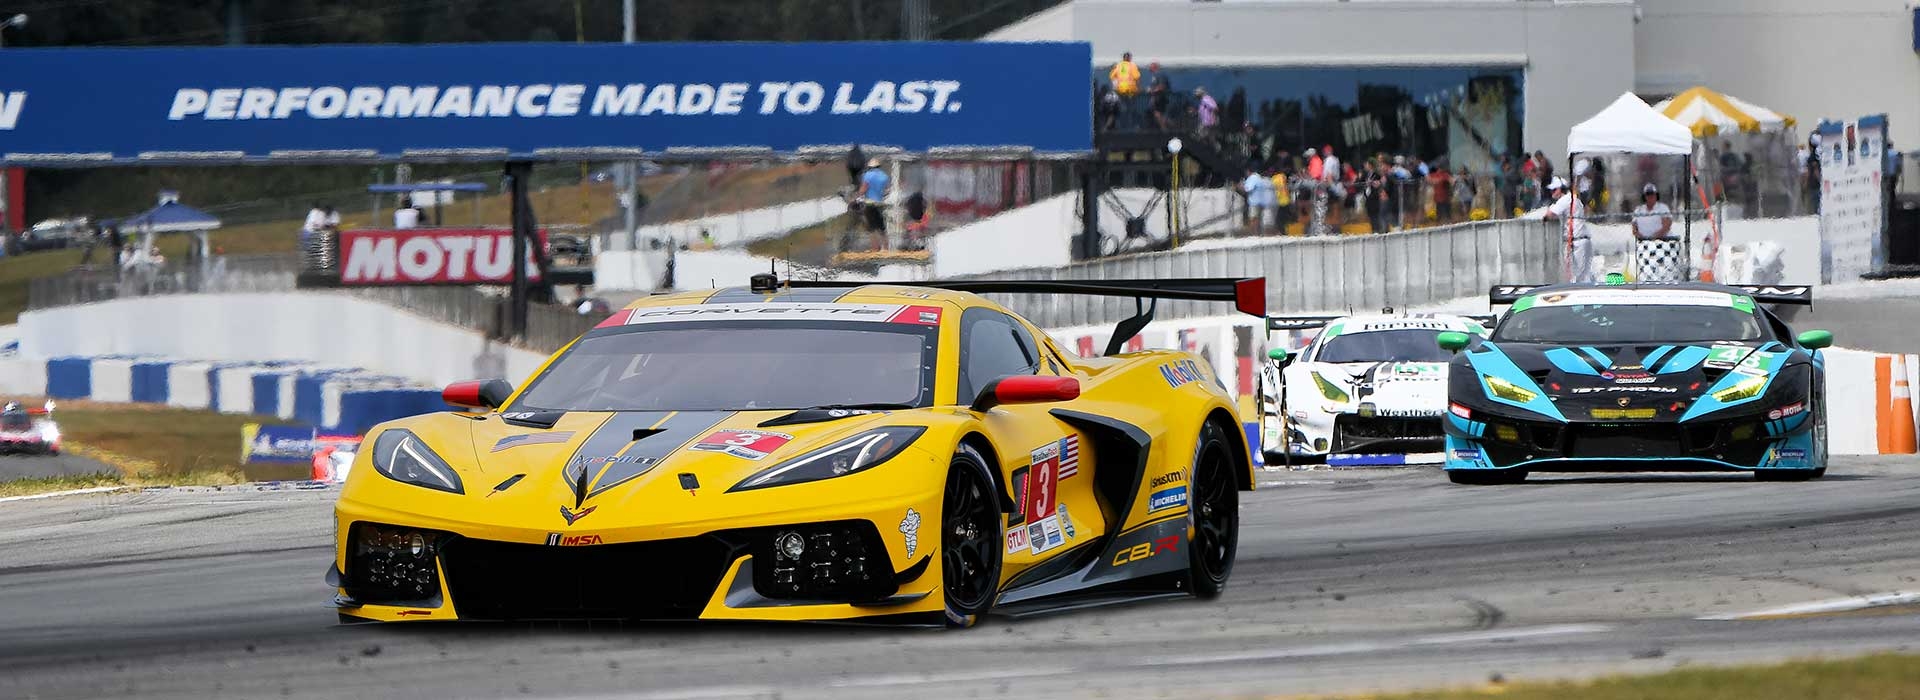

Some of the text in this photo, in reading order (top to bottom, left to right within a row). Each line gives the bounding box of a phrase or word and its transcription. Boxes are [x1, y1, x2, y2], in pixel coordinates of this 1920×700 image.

[168, 80, 962, 120] PERFORMANCE MADE TO LAST.
[639, 307, 884, 318] CORVETTE
[724, 433, 763, 447] 3
[1036, 462, 1050, 518] 3
[1154, 492, 1187, 508] MICHELIN
[562, 534, 604, 546] IMSA
[1007, 528, 1028, 550] GTLM
[1112, 535, 1180, 567] C8.R
